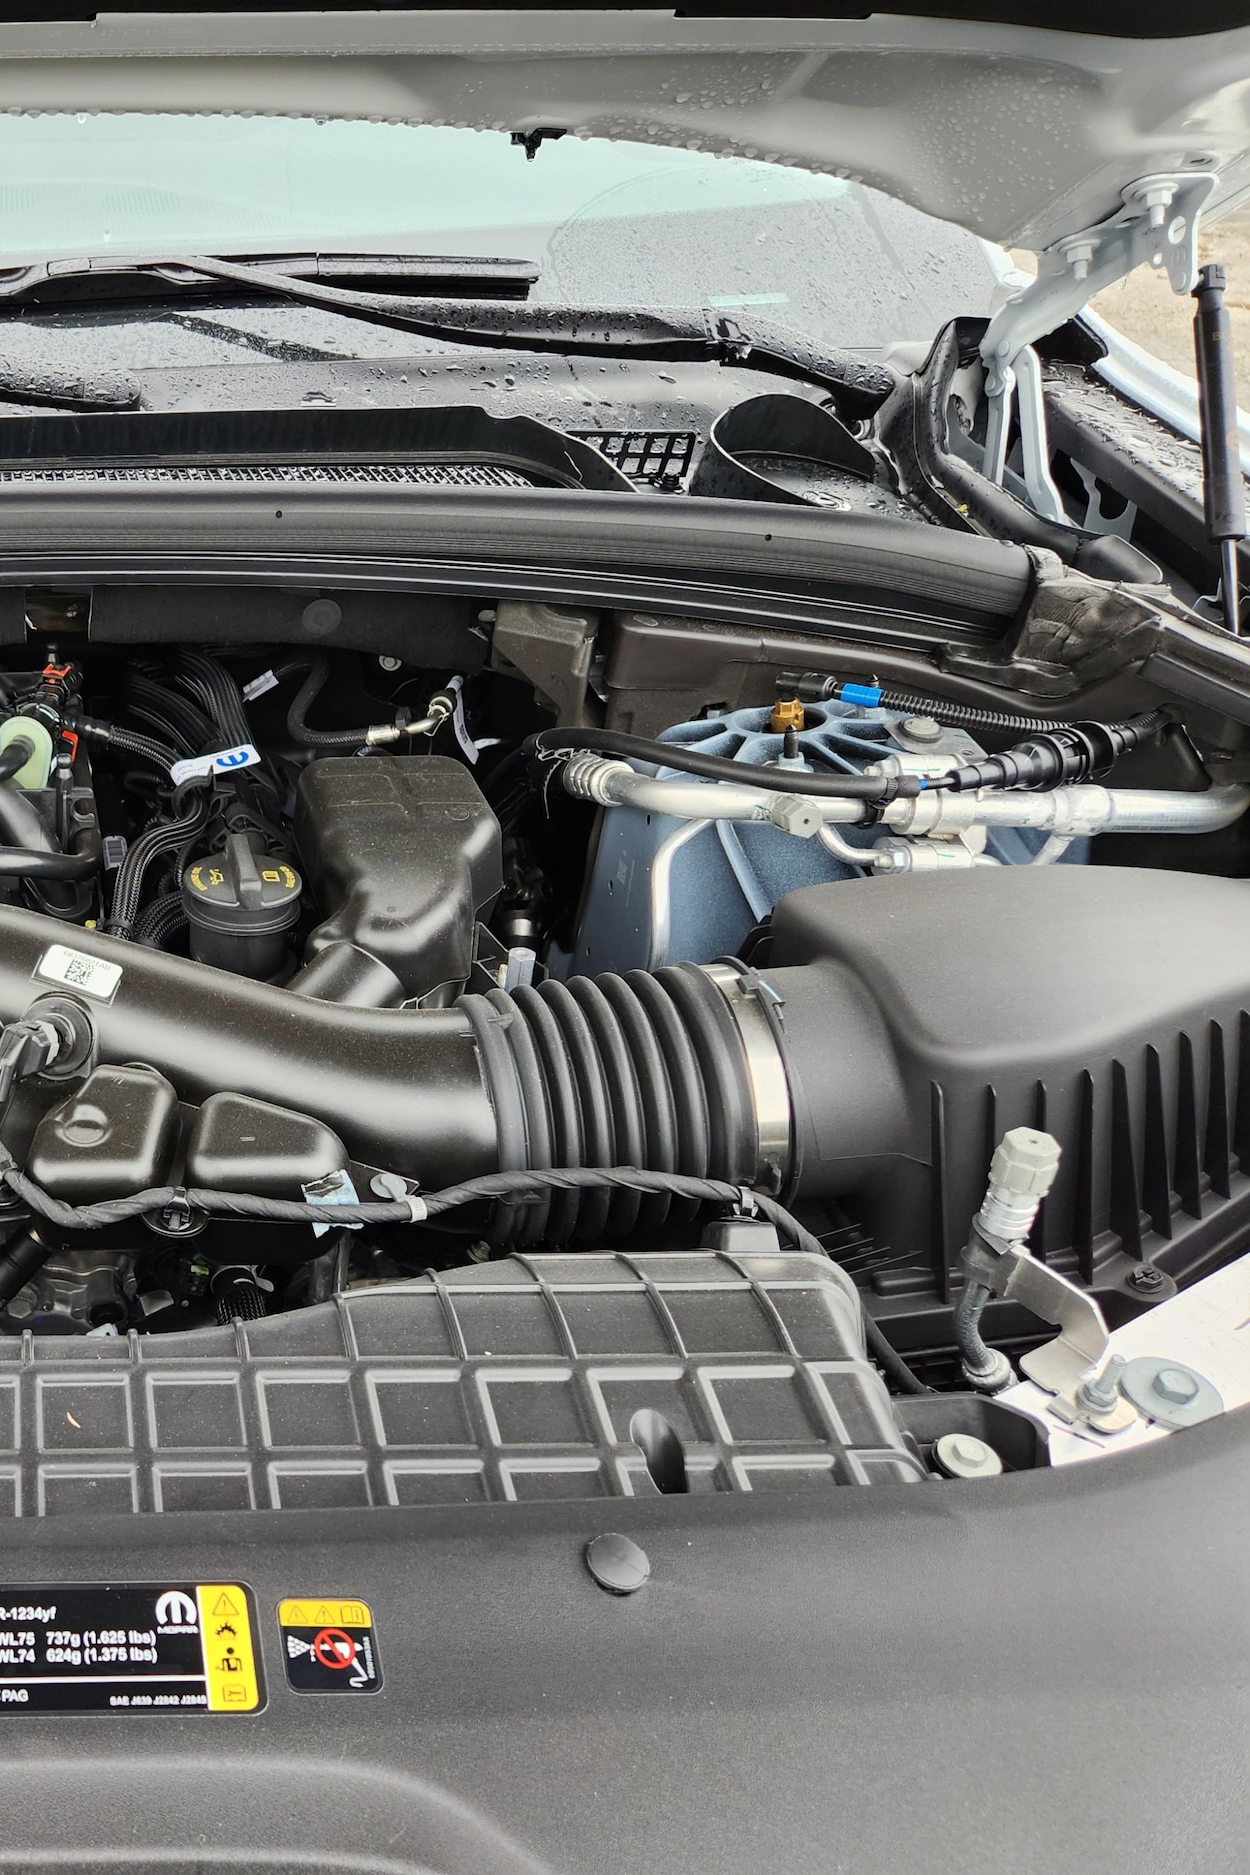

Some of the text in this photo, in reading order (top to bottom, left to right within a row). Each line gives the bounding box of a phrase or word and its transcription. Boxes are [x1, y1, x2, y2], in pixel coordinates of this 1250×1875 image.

[46, 1631, 81, 1647] 737g
[83, 1630, 126, 1647] (1.625
[129, 1629, 157, 1647] lbs)
[46, 1648, 81, 1665] 624g
[83, 1647, 127, 1664] (1.375
[130, 1646, 158, 1664] lbs)
[1, 1688, 29, 1703] PAG
[109, 1695, 130, 1706] SAE
